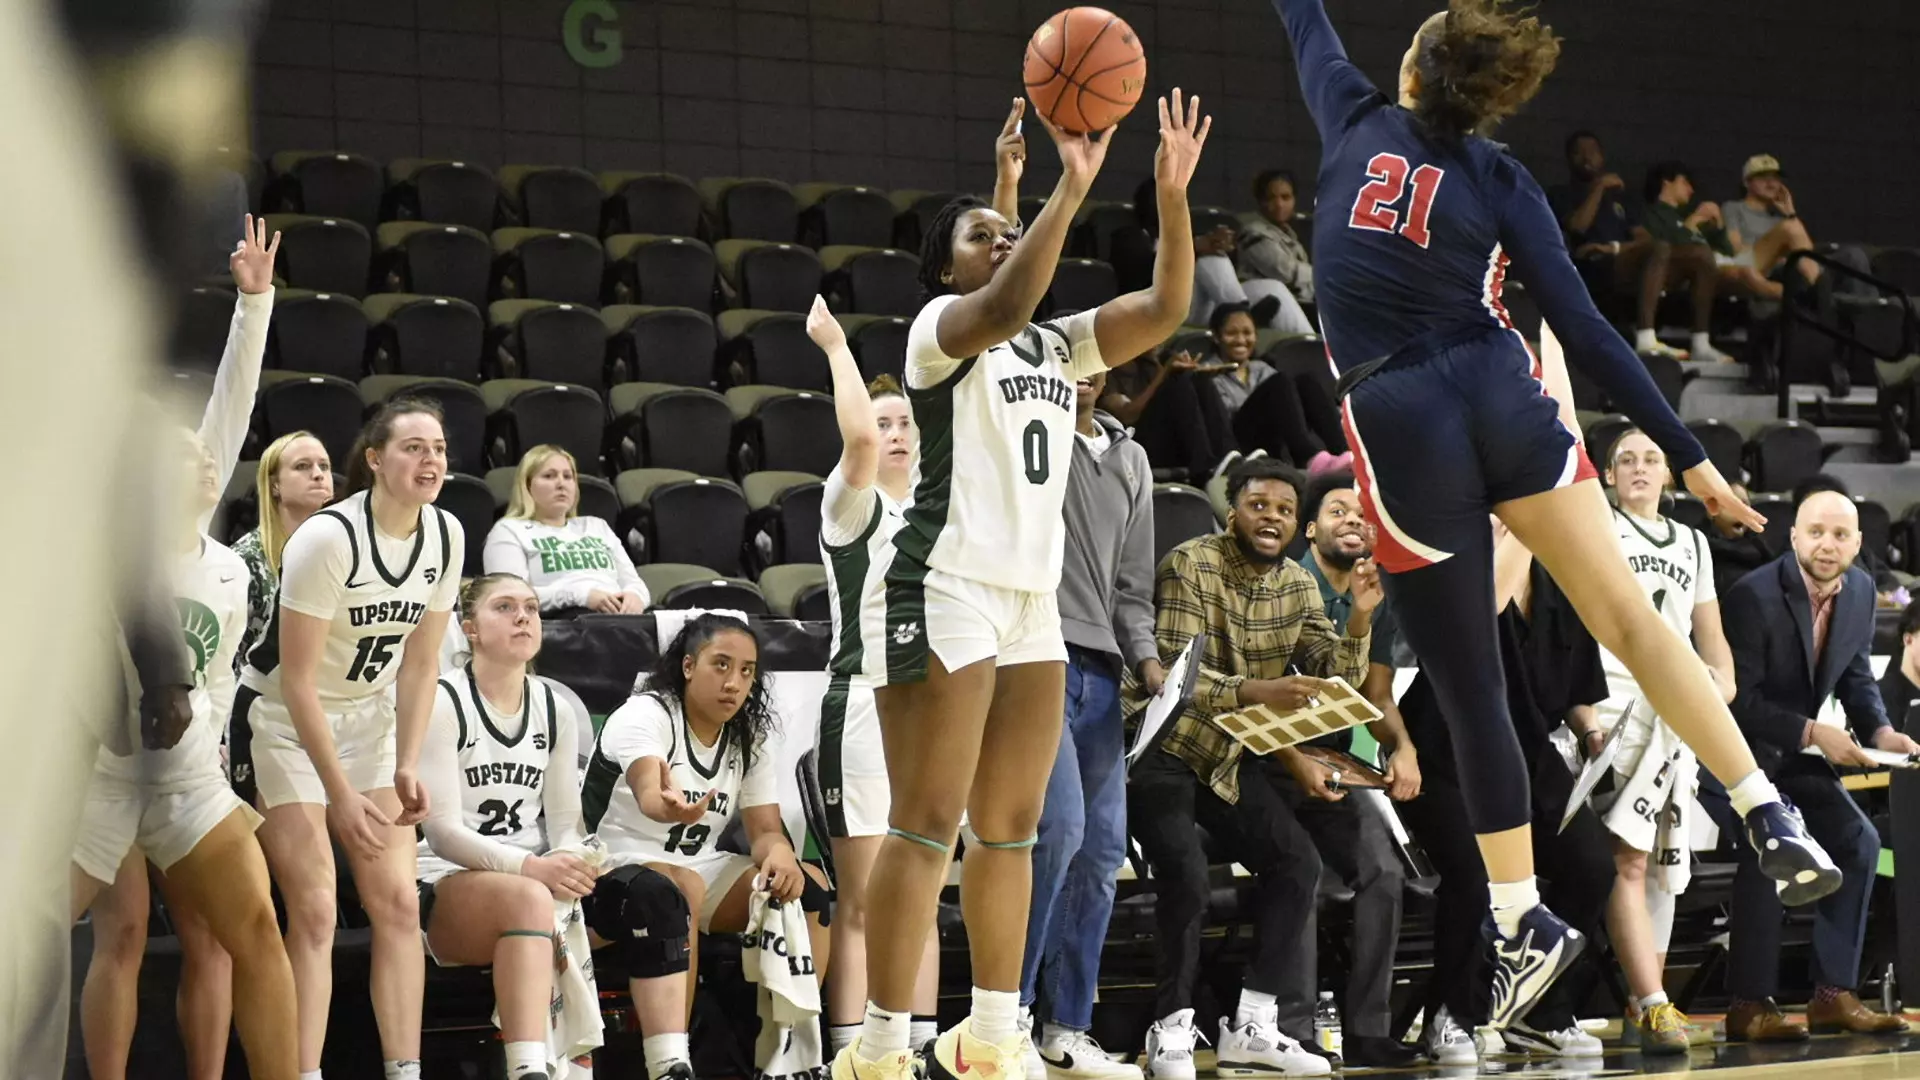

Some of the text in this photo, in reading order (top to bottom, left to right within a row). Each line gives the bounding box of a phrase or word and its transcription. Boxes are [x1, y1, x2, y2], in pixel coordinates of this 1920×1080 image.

[563, 0, 622, 68] G
[1348, 152, 1445, 249] 21
[998, 374, 1073, 412] UPSTATE
[1023, 419, 1050, 485] 0
[1628, 554, 1692, 592] UPSTATE
[345, 633, 405, 683] 15
